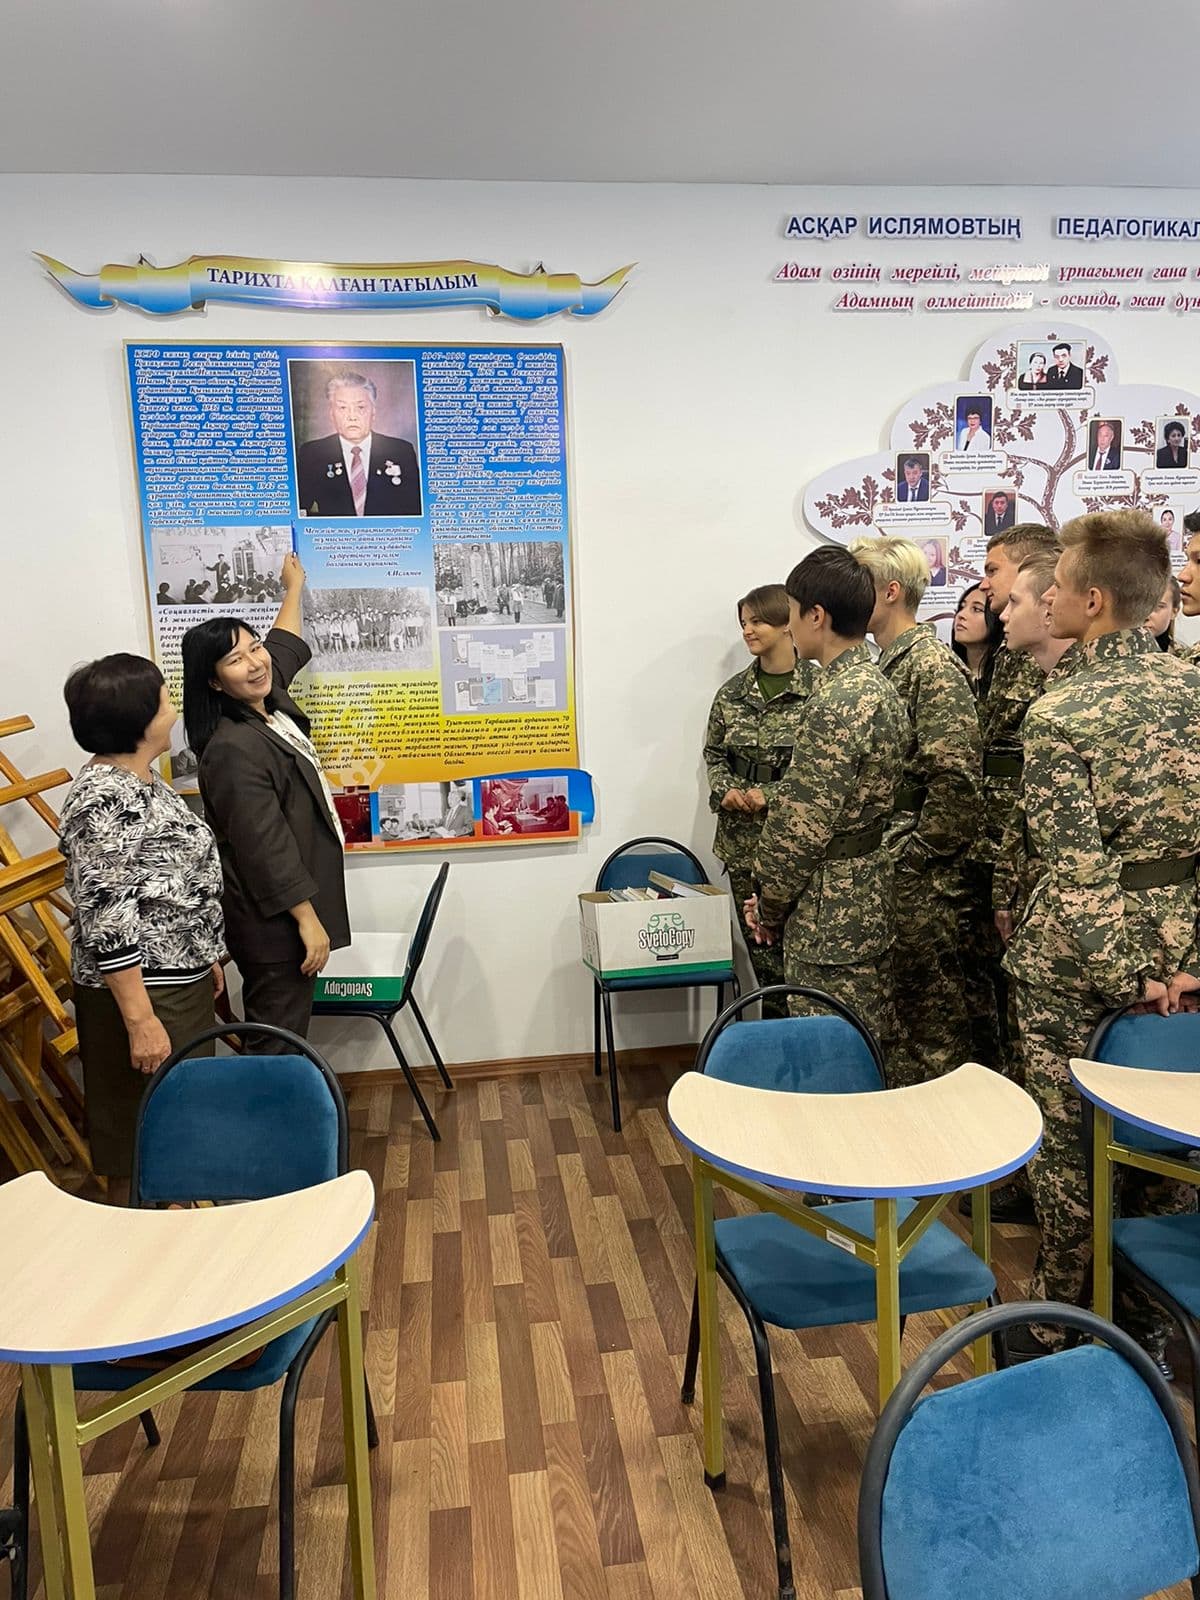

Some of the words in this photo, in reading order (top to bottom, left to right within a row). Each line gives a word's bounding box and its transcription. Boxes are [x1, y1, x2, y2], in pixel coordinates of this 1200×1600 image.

[787, 217, 857, 237] АСҚАР
[869, 217, 1020, 239] ИСЛЯМОВТЫҢ
[207, 268, 295, 289] ТАРИХТА
[380, 274, 478, 292] ТАҒЫЛЫМ
[777, 263, 821, 278] Адам
[833, 263, 882, 281] өзінің
[892, 263, 960, 283] мерейлі,
[836, 293, 914, 310] Адамның
[1060, 290, 1120, 307] осында,
[1130, 296, 1166, 307] жан
[638, 928, 695, 949] SvetoCopy
[324, 980, 373, 997] SvetoCopy
